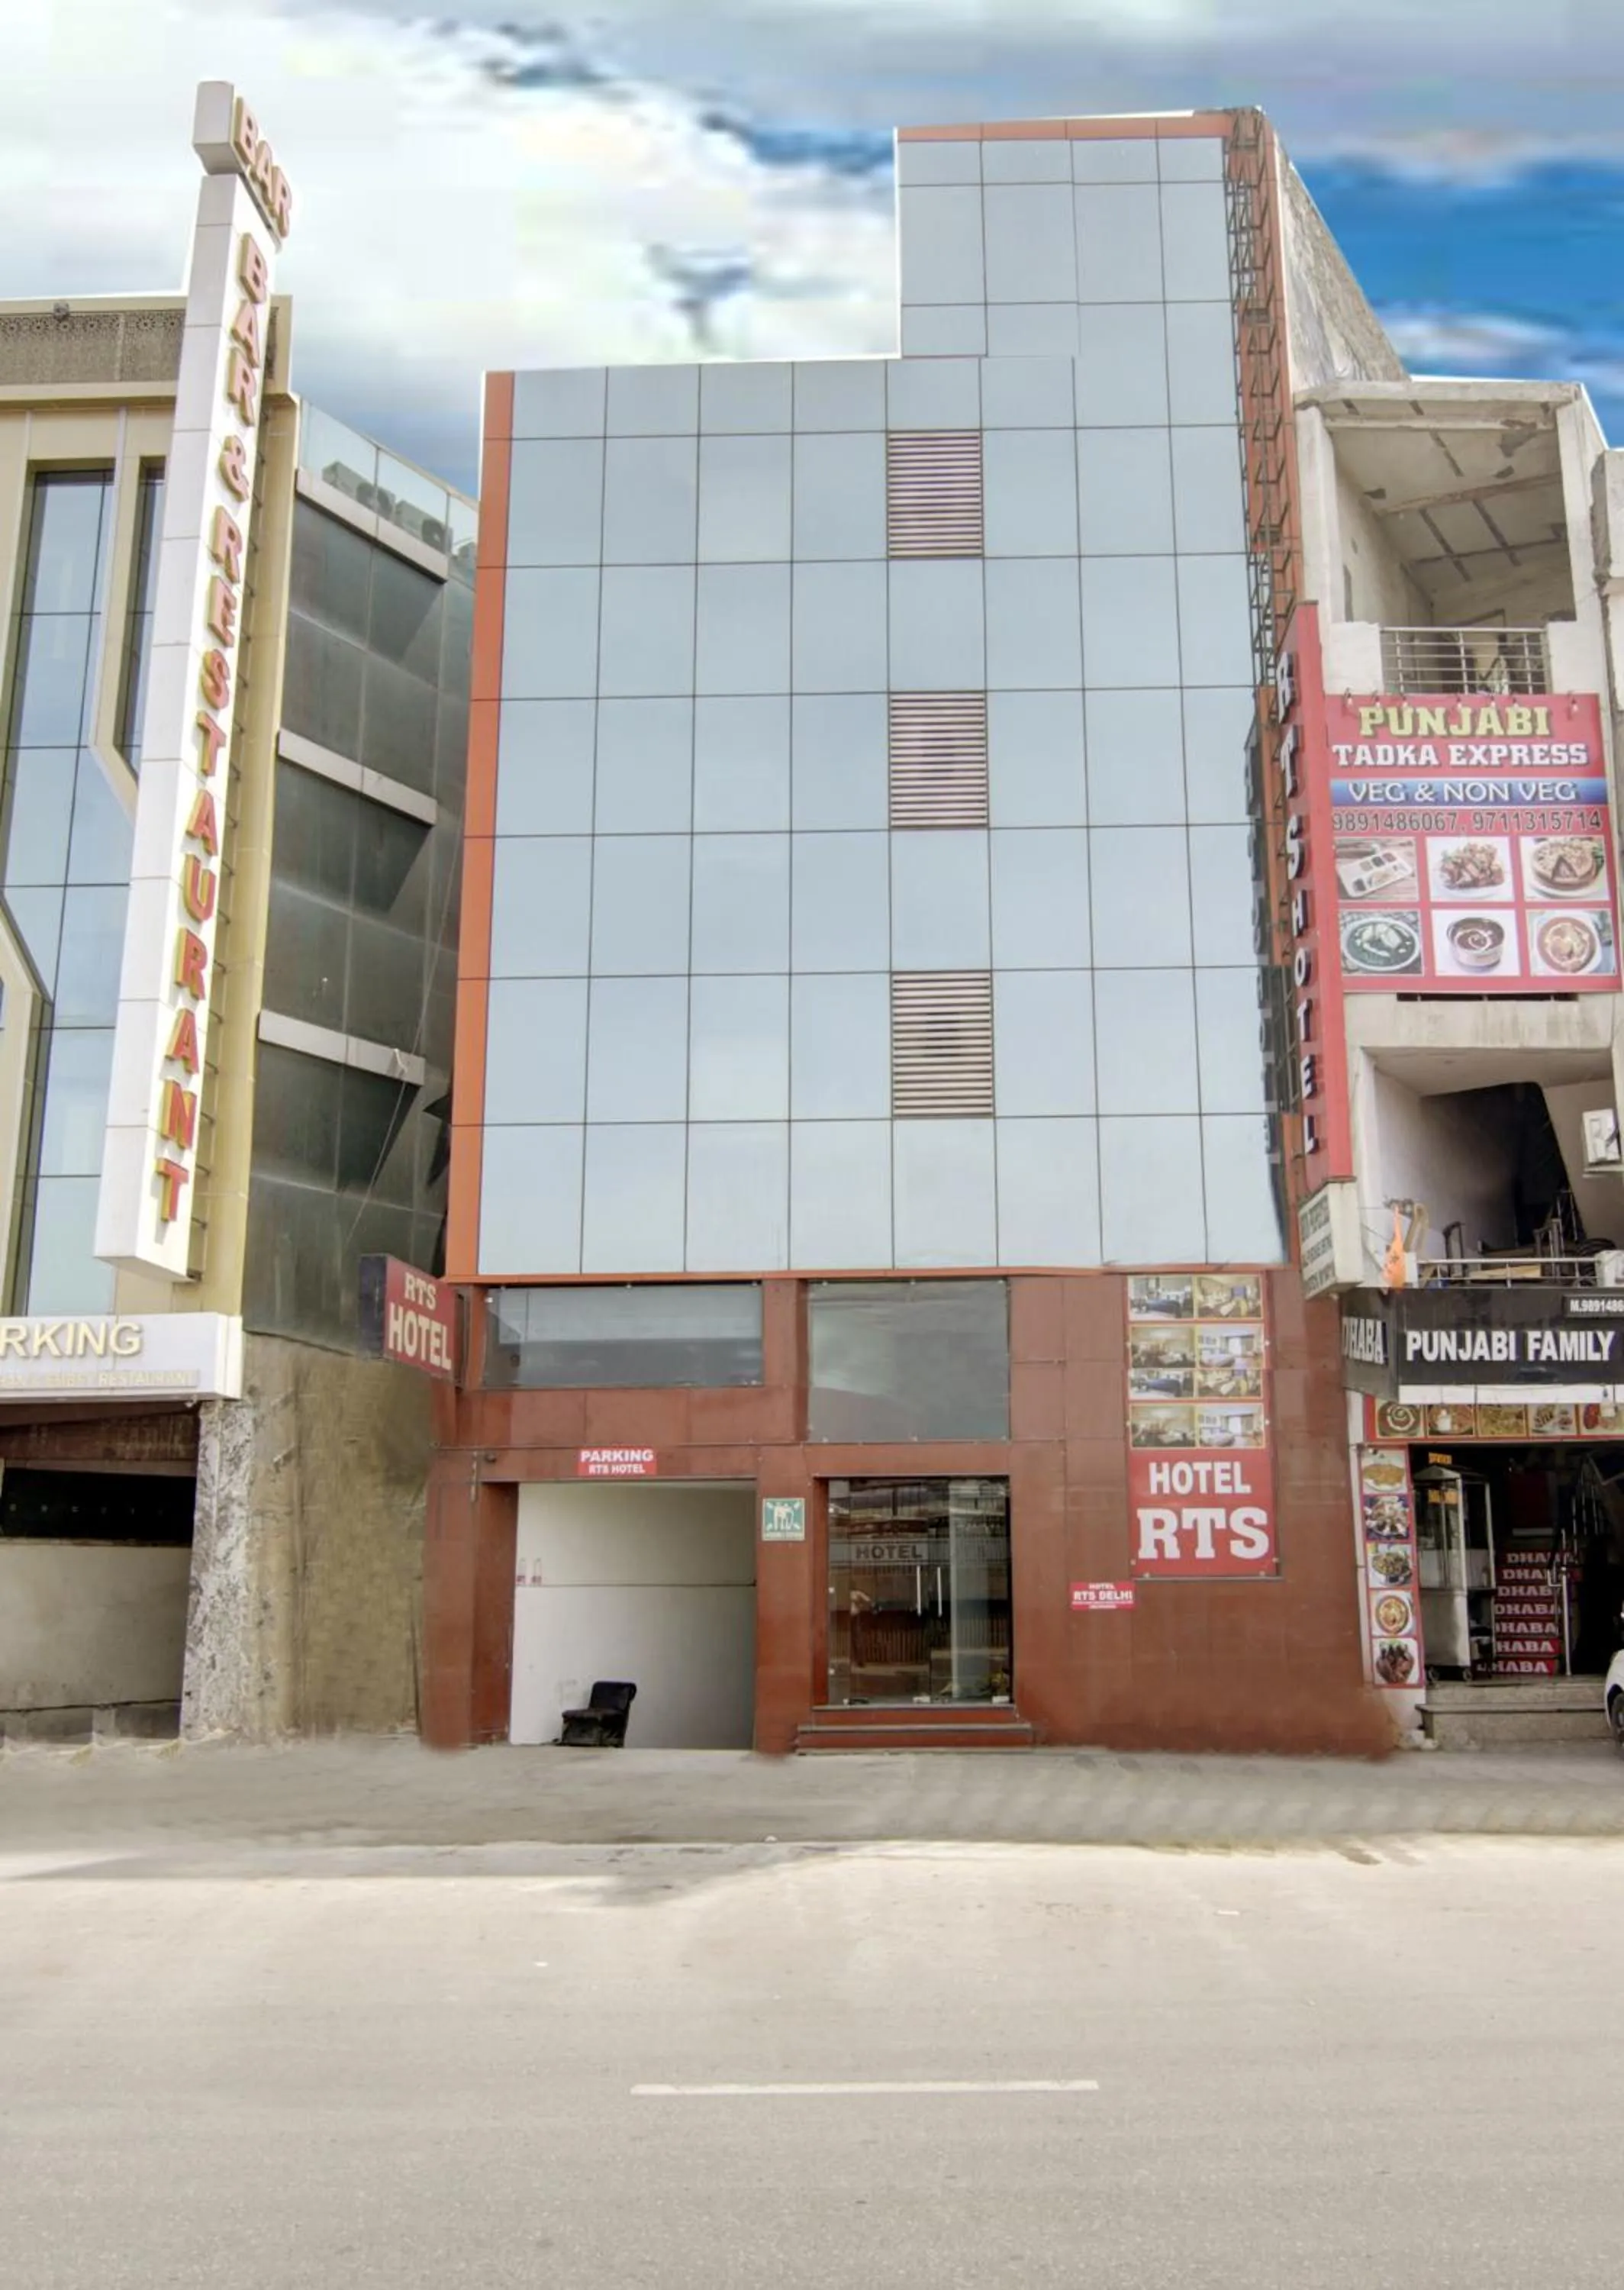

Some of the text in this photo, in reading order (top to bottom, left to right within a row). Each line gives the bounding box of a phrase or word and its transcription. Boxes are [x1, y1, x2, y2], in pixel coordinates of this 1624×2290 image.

[233, 96, 292, 237] BAR
[228, 232, 267, 426] BAR
[1358, 706, 1551, 737] PUNJABI
[1332, 743, 1589, 766] TADKA EXPRESS
[1348, 780, 1577, 802] VEG & NON VEG
[1473, 810, 1602, 832] 9711315714
[156, 505, 243, 1223] RESTAURANT
[1291, 889, 1319, 1155] HOTEL
[404, 1272, 437, 1311] RTS
[388, 1301, 453, 1371] HOTEL
[1406, 1330, 1616, 1363] PUNJABI FAMILY
[580, 1449, 654, 1462] PARKING
[588, 1463, 646, 1475] RTS HOTEL
[1149, 1460, 1252, 1495] HOTEL
[1136, 1506, 1270, 1560] RTS
[854, 1544, 923, 1560] HOTEL
